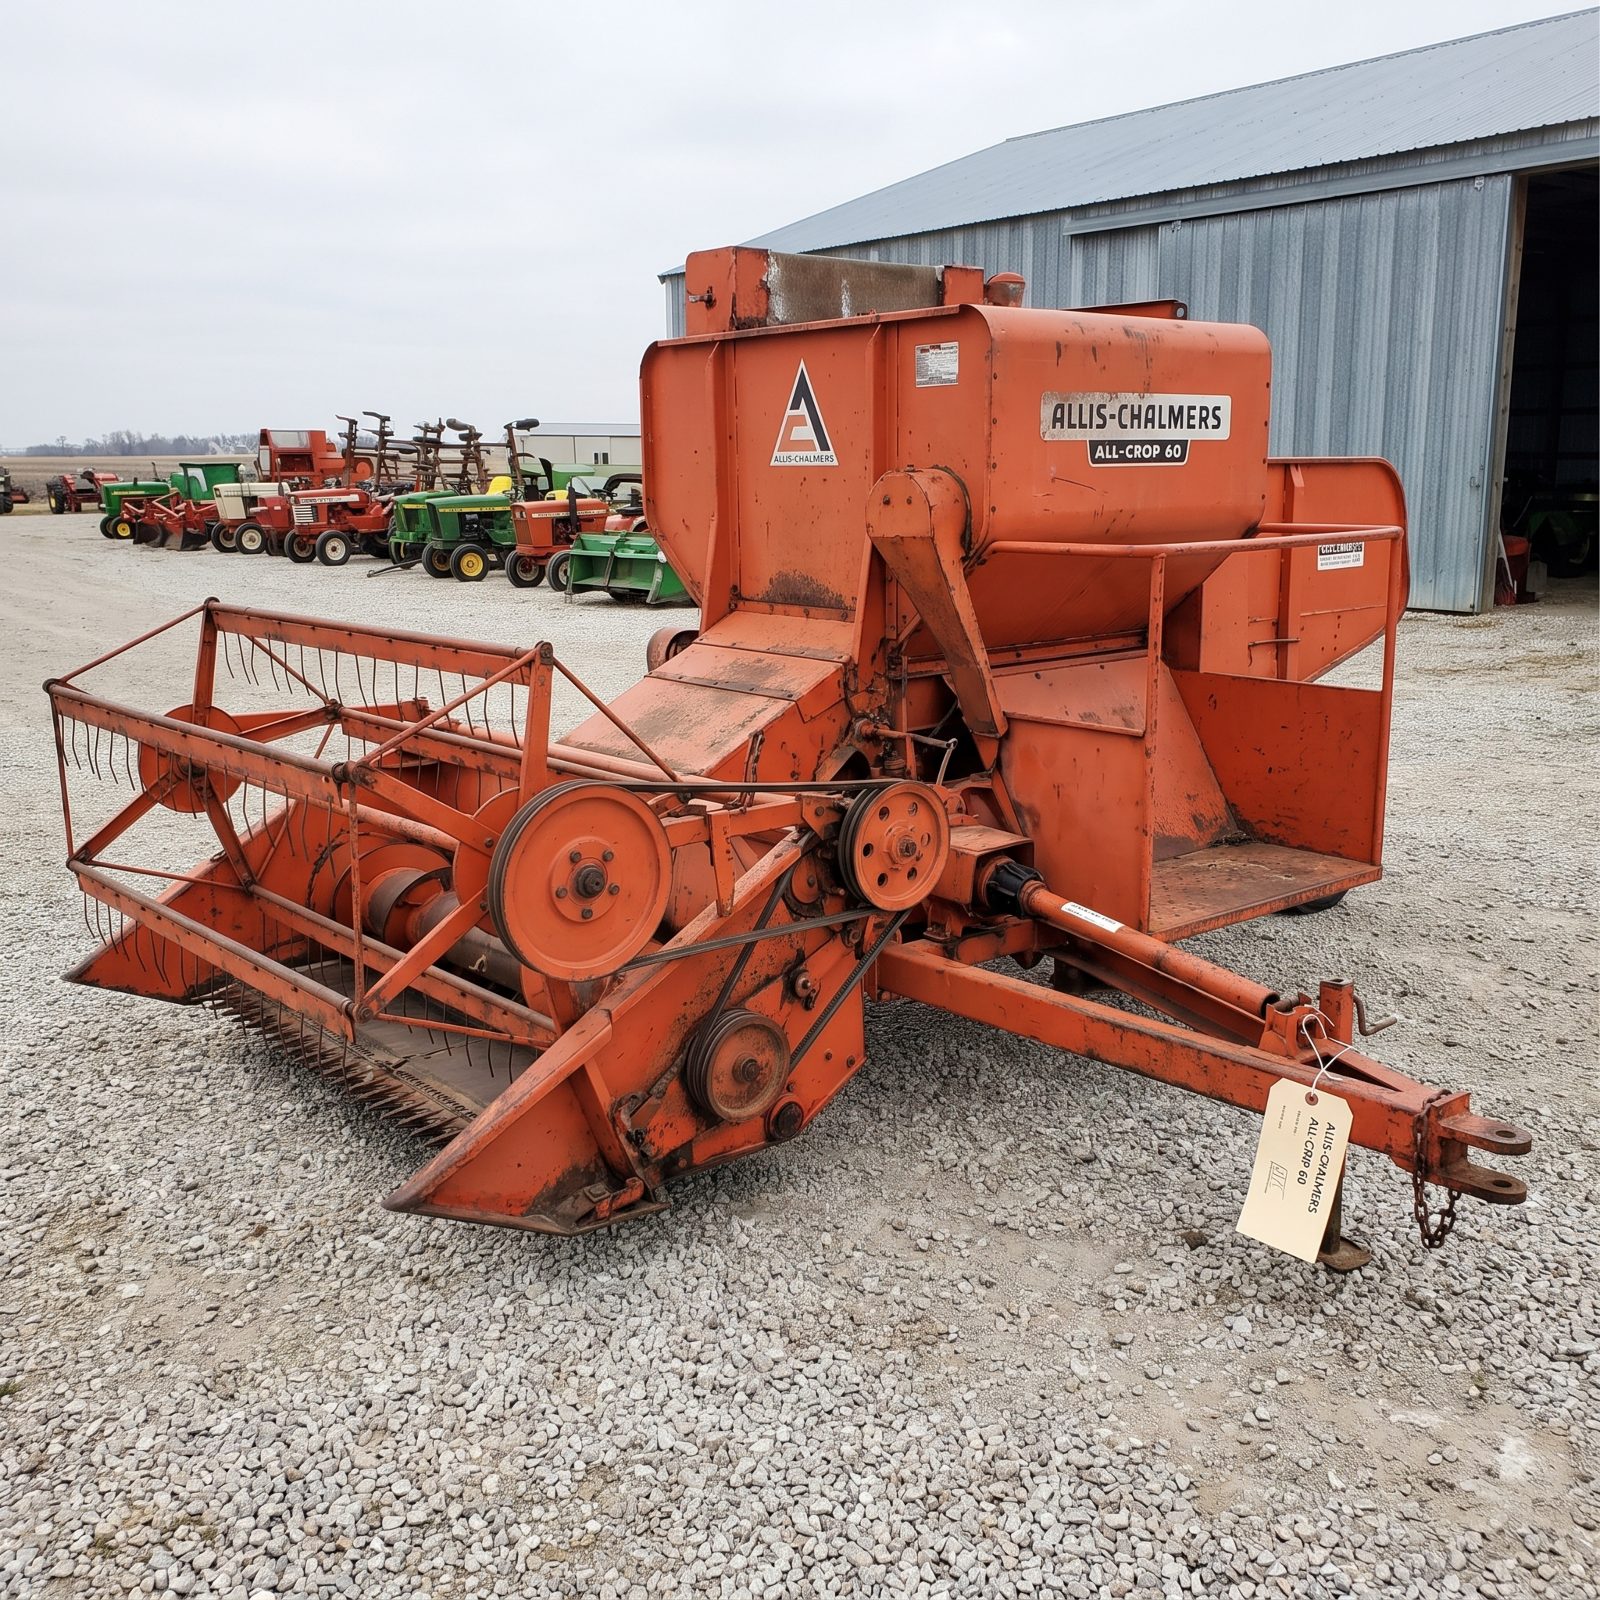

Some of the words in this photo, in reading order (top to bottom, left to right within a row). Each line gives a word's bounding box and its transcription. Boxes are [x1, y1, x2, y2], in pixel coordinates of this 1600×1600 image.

[1052, 403, 1222, 430] ALLIS-CHALMERS
[774, 454, 835, 463] ALLIS-CHALMERS
[1094, 444, 1160, 459] ALL-CROP
[1165, 444, 1182, 458] 60
[1297, 1170, 1308, 1185] 60
